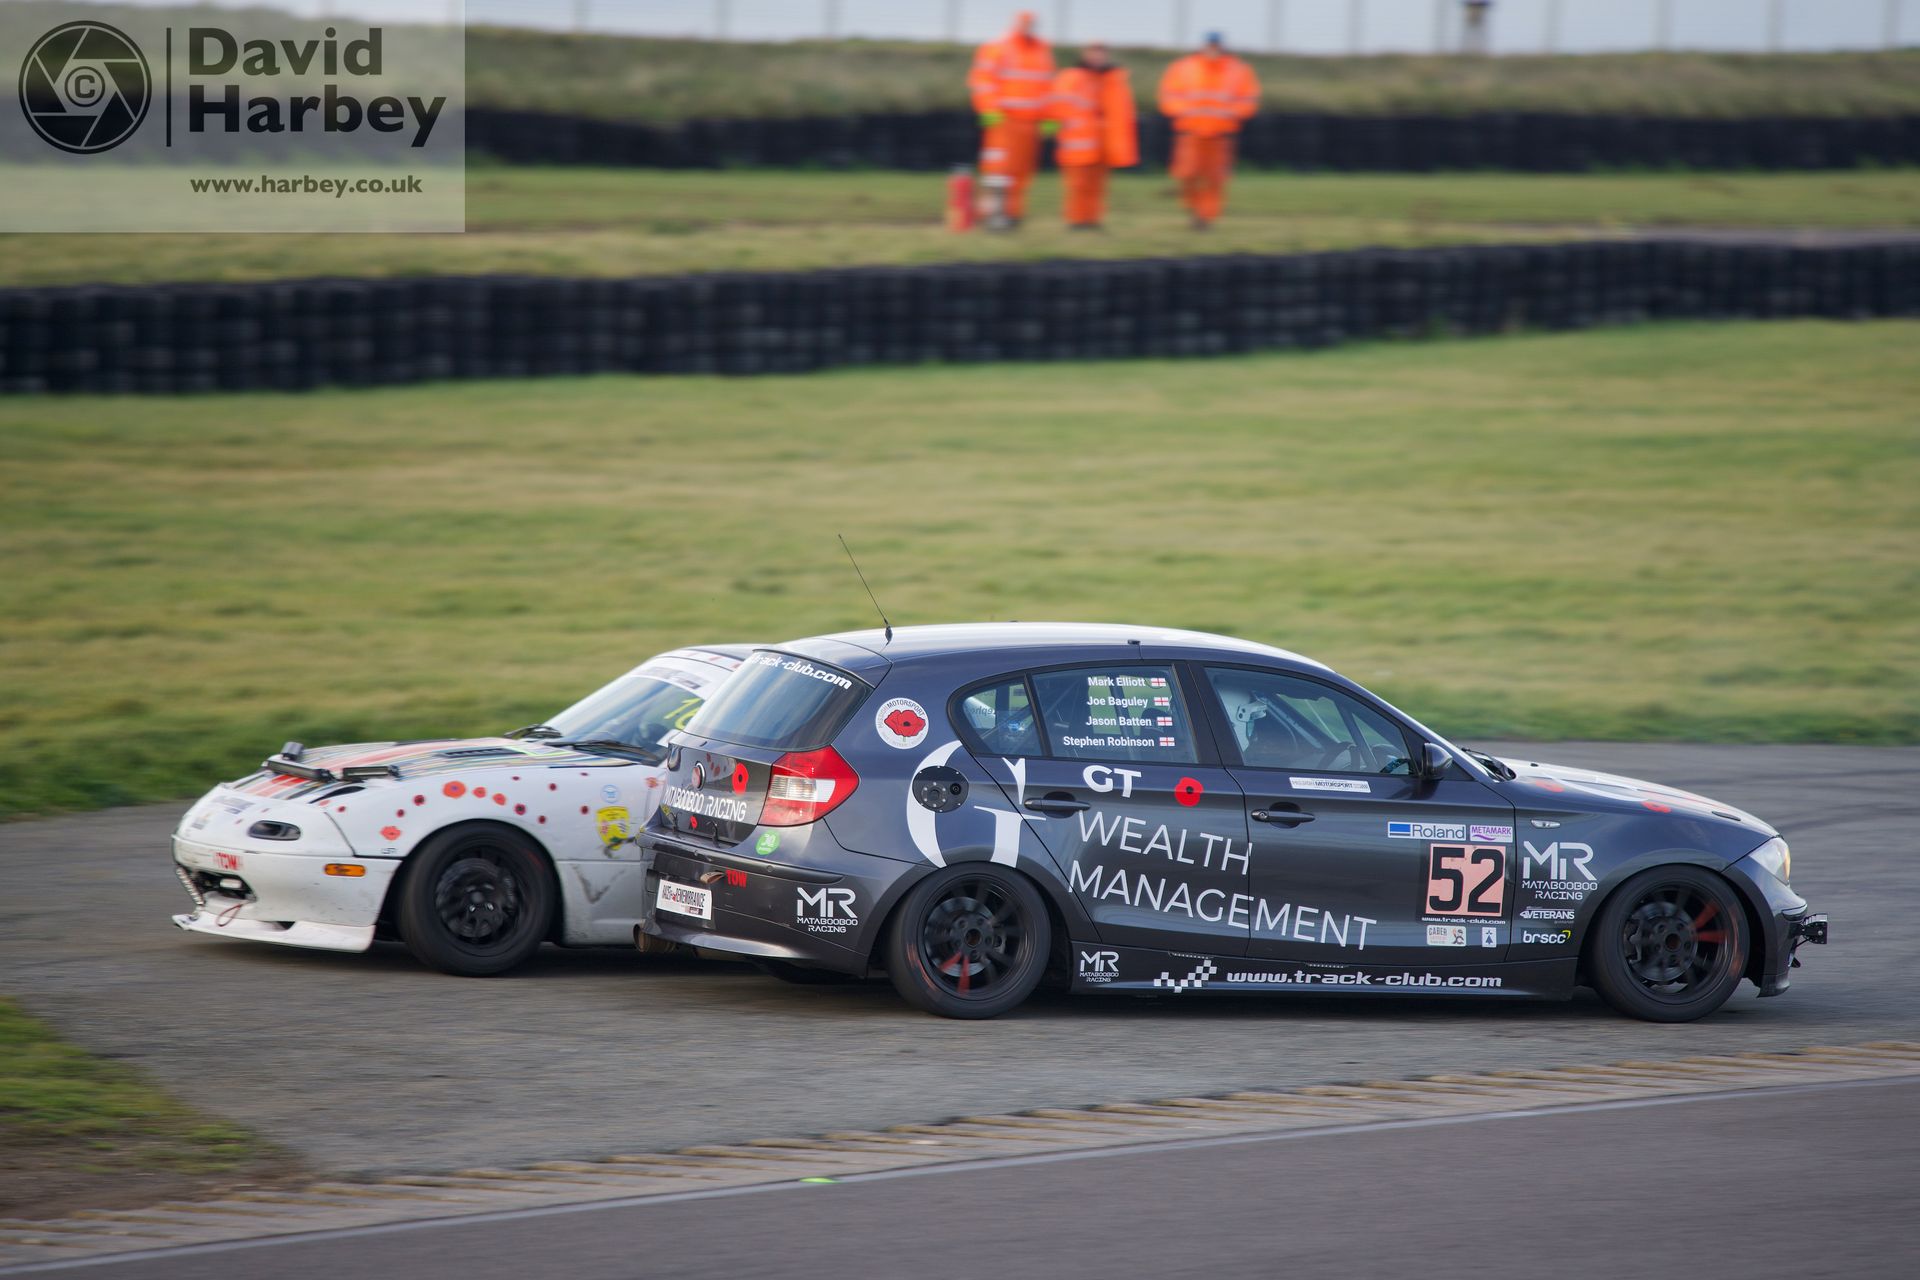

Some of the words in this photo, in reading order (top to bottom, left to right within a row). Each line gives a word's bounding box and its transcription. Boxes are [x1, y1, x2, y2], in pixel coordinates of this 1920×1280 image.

[1087, 676, 1115, 688] Mark
[1116, 676, 1147, 688] Elliott
[1086, 696, 1106, 707] Joe
[1107, 696, 1149, 709] Baguley
[1085, 716, 1117, 727] Jason
[1118, 716, 1152, 728] Batten
[1063, 736, 1106, 749] Stephen
[1107, 736, 1155, 748] Robinson
[1083, 765, 1142, 799] GT
[1315, 781, 1353, 789] MOTORSPORT
[705, 795, 748, 822] RACING
[1412, 824, 1465, 839] Roland
[1471, 826, 1512, 836] METAMARK
[1078, 810, 1253, 876] WEALTH
[1522, 840, 1598, 881] MR
[726, 869, 748, 889] TOW
[1429, 847, 1504, 913] 52
[1521, 880, 1599, 891] MATABOOBOO
[1535, 890, 1584, 901] RACING
[796, 887, 858, 919] MR
[1068, 859, 1378, 951] MANAGEMENT
[796, 917, 860, 926] MATABOOBOO
[1421, 917, 1506, 925] www.track-club.com
[1524, 910, 1575, 920] VETERANS
[808, 924, 847, 934] RACING
[1522, 930, 1567, 944] brscc
[1080, 950, 1120, 972] MR
[1226, 970, 1502, 988] www.track-club.com
